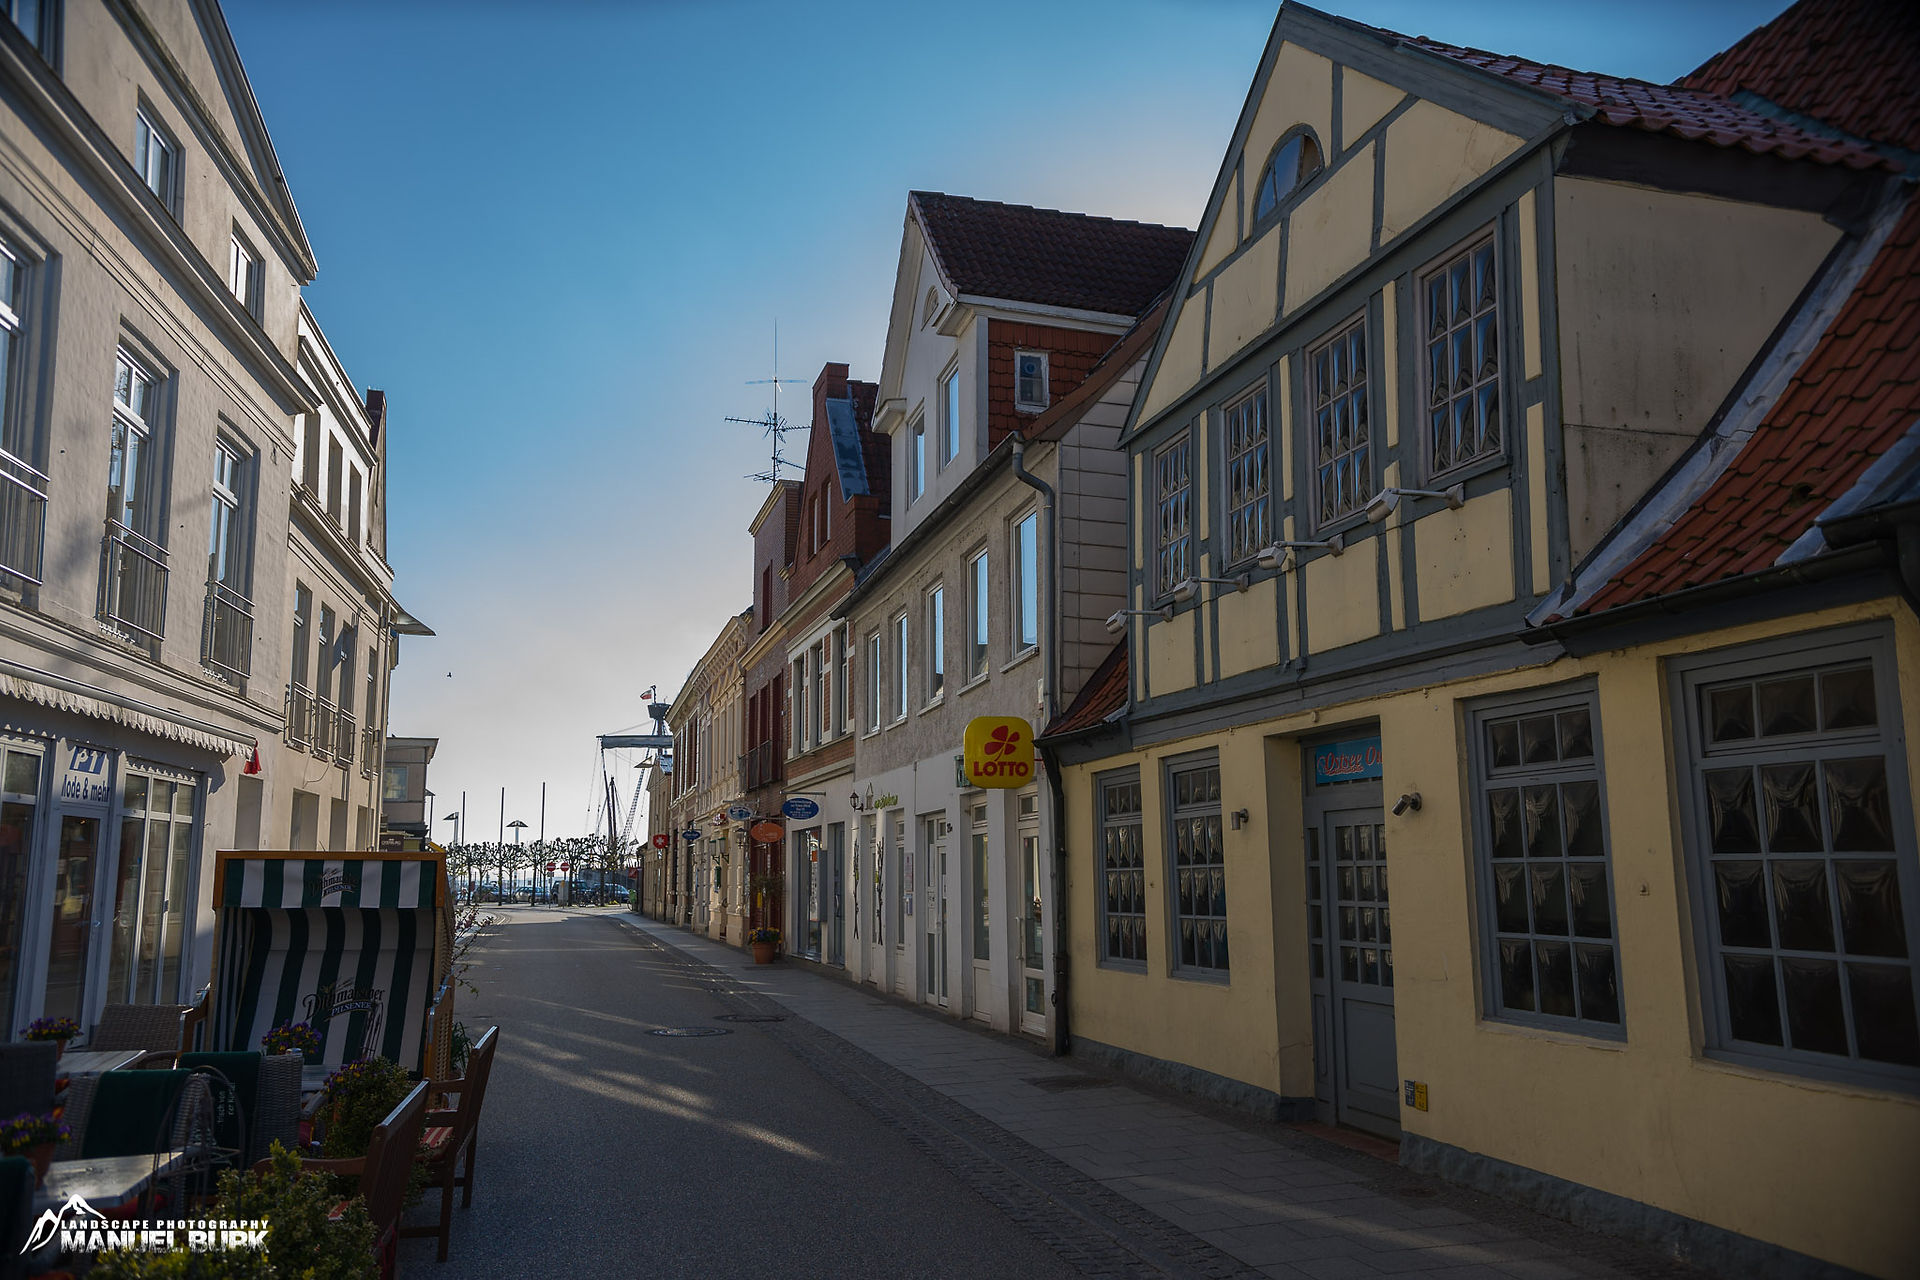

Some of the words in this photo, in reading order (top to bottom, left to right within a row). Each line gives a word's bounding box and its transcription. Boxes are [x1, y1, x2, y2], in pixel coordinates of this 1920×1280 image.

[73, 748, 99, 773] P1
[974, 761, 1029, 777] LOTTO
[82, 777, 89, 799] &
[90, 780, 110, 802] mehr
